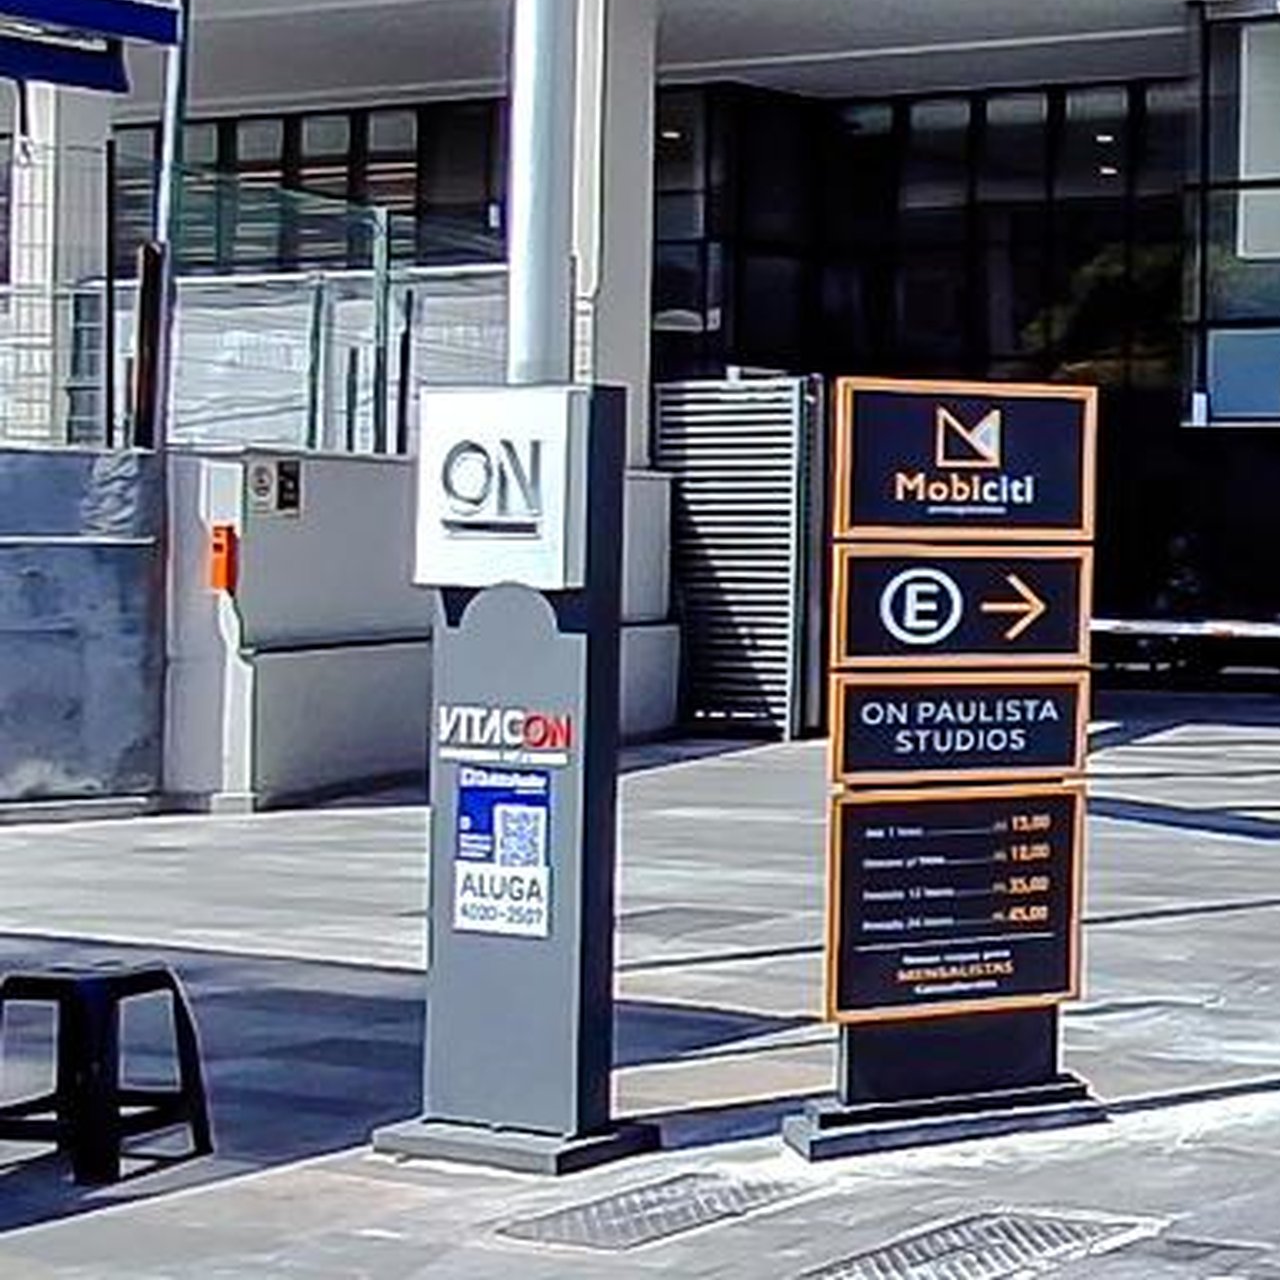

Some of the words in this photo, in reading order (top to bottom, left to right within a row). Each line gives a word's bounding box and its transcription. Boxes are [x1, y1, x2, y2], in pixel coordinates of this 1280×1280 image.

[442, 439, 542, 517] ON
[894, 472, 1034, 504] Mobiciti
[438, 705, 573, 748] VITACON
[861, 701, 908, 725] ON
[916, 699, 1059, 724] PAULISTA
[894, 728, 1027, 753] STUDIOS
[459, 872, 544, 904] ALUGA
